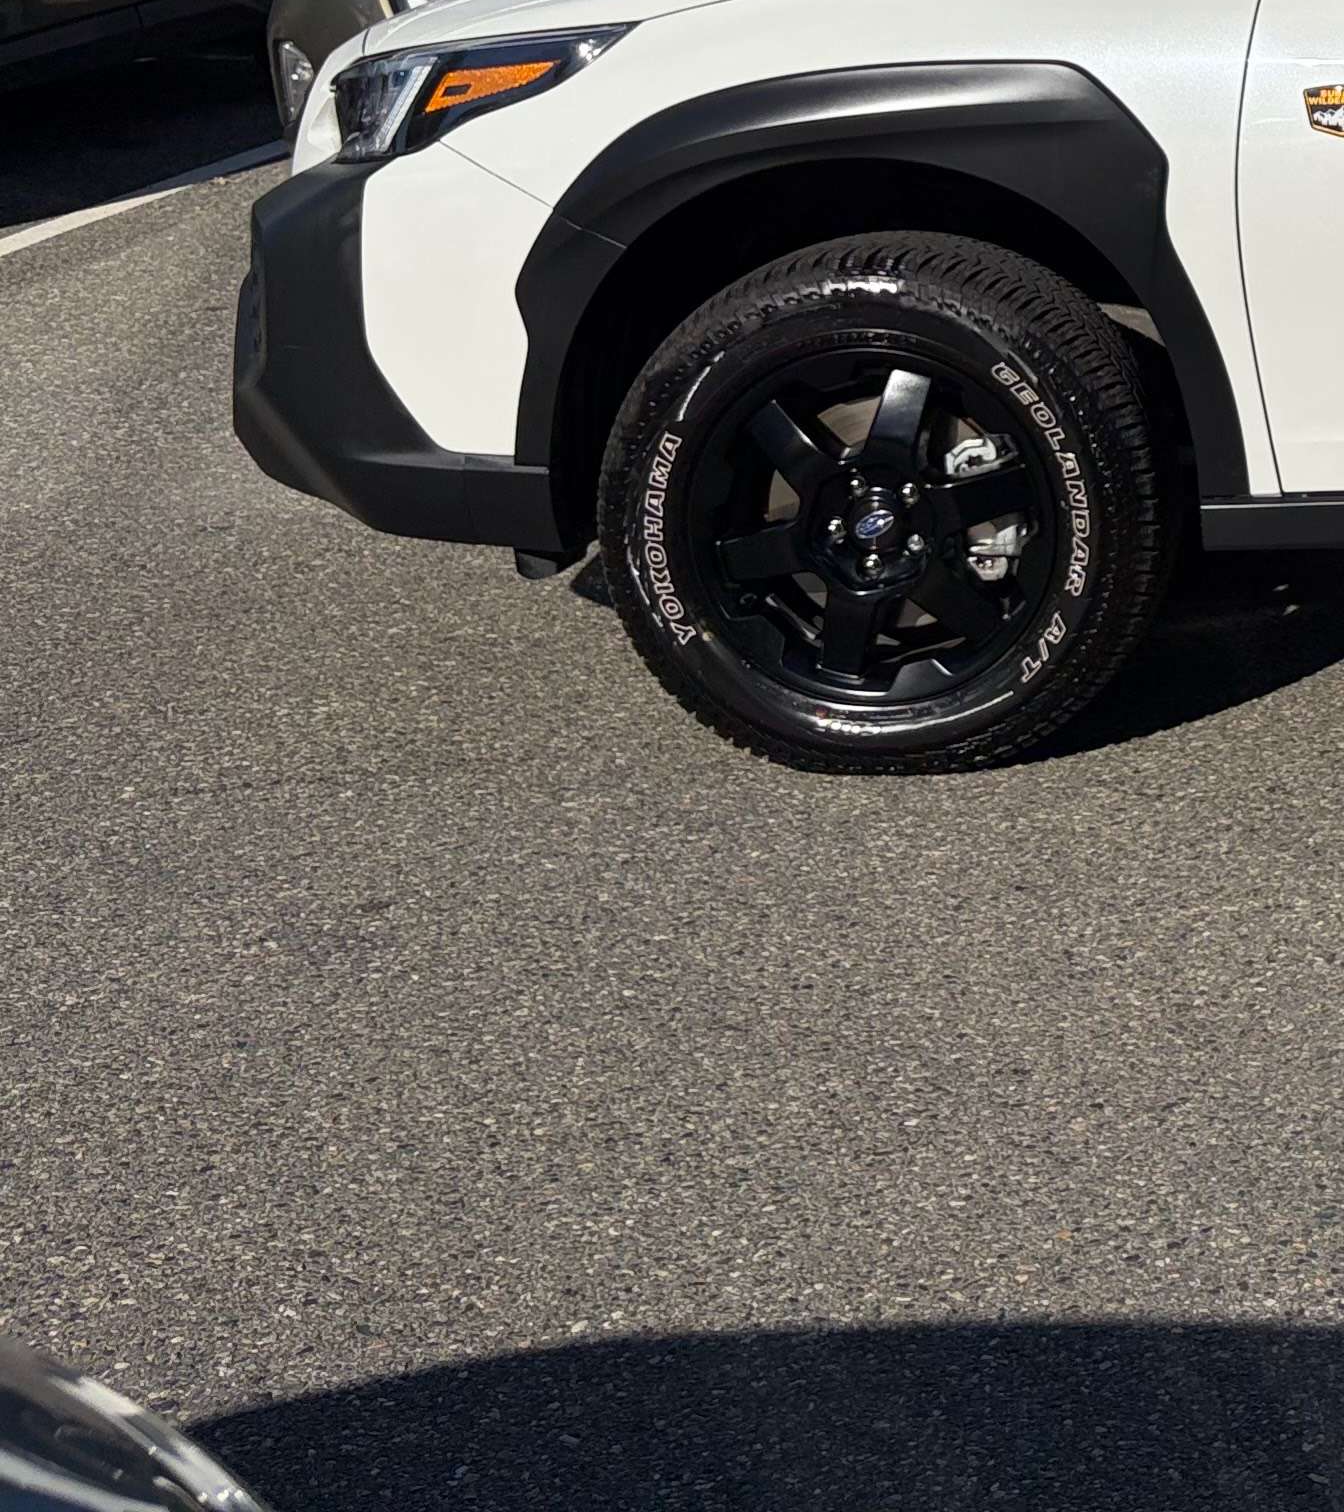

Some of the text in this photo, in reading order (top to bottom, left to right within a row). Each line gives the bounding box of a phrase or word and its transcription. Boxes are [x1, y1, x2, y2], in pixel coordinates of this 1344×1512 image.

[644, 431, 697, 646] YOKOHAMA
[991, 361, 1090, 684] GEOLANDAR A/T
